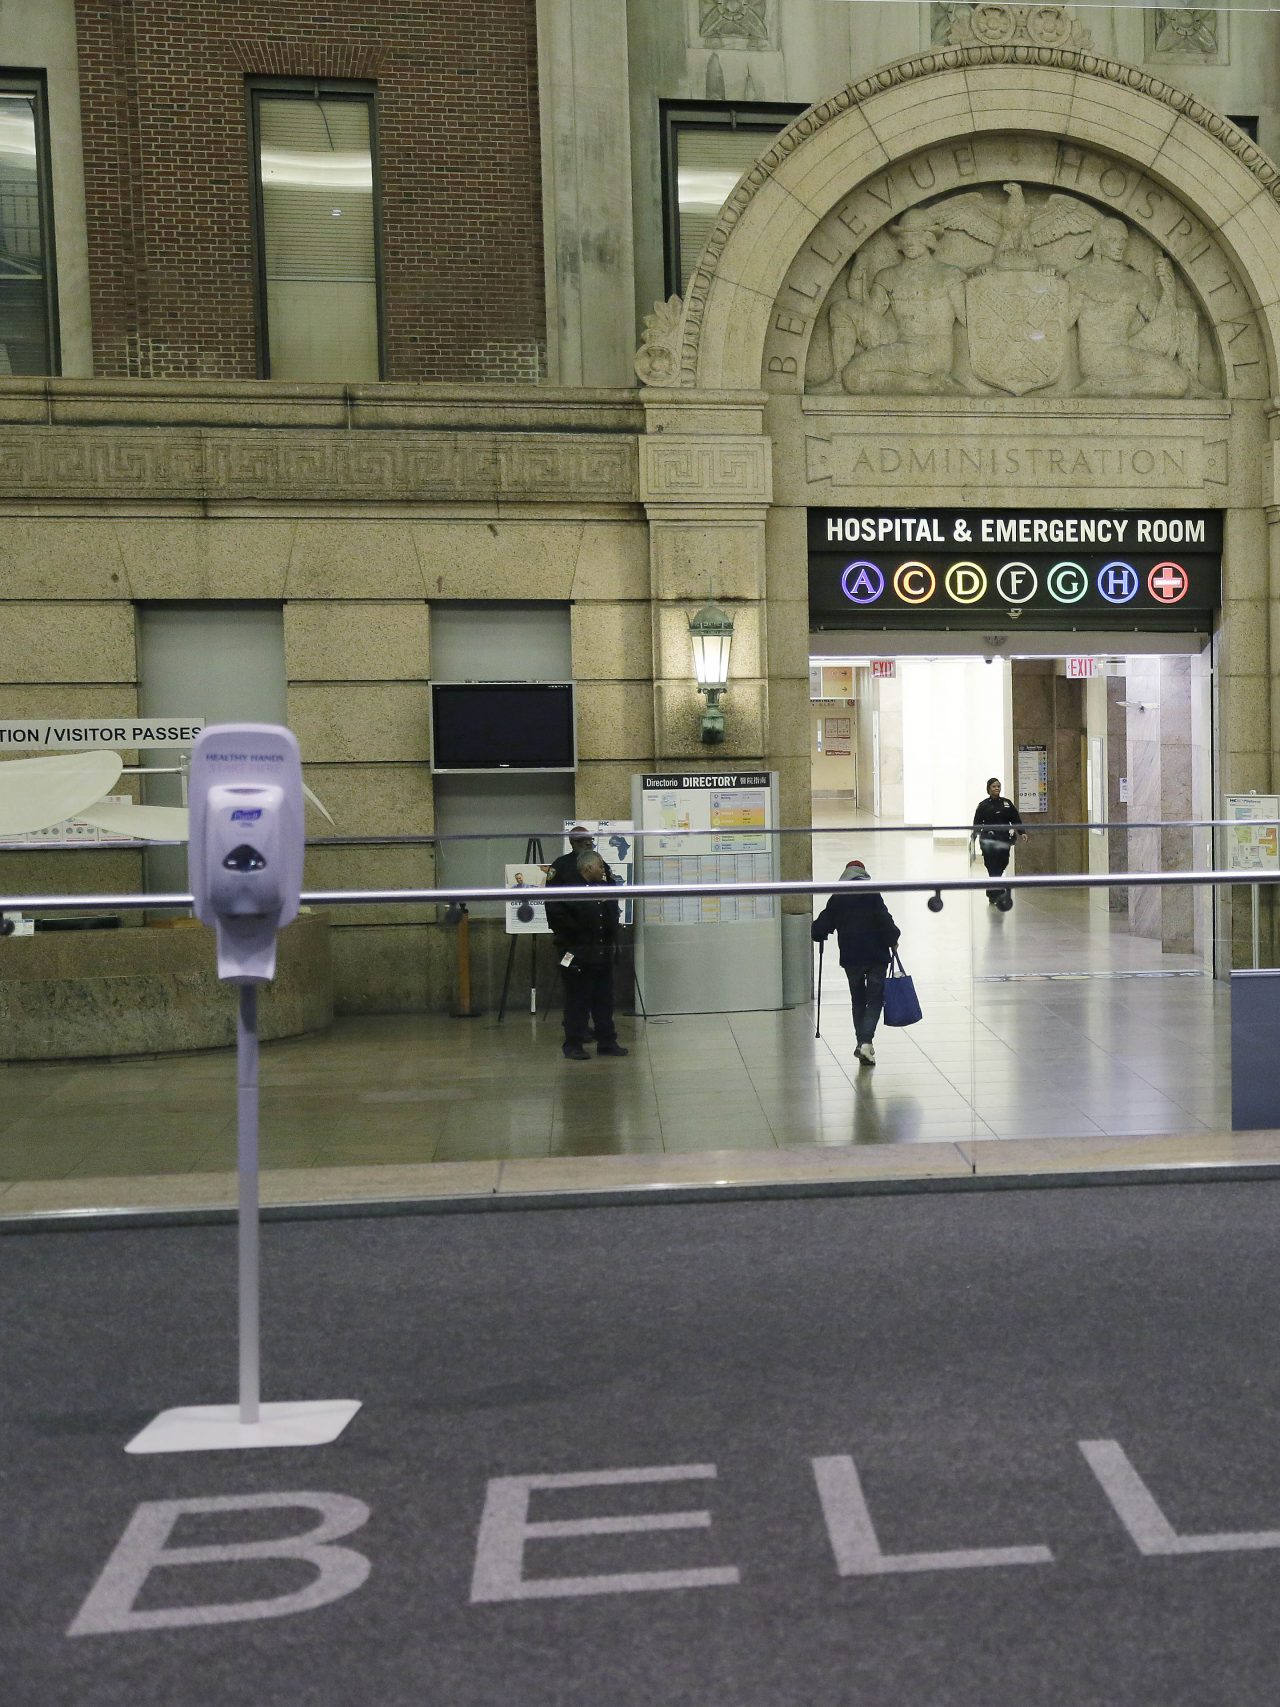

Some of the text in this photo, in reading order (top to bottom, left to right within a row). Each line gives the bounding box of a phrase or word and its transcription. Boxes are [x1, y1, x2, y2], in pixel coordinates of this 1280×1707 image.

[768, 140, 1260, 380] BELLEVUE HOSPITAL
[851, 447, 1185, 475] ADMINISTRATION
[827, 518, 1206, 544] HOSPITAL & EMERGENCY ROOM
[872, 661, 893, 677] EXIT
[1070, 659, 1094, 677] EXIT
[132, 727, 202, 741] PASSES
[206, 753, 284, 762] HEALTHY HANDS
[646, 776, 738, 788] Directorio DIRECTORY
